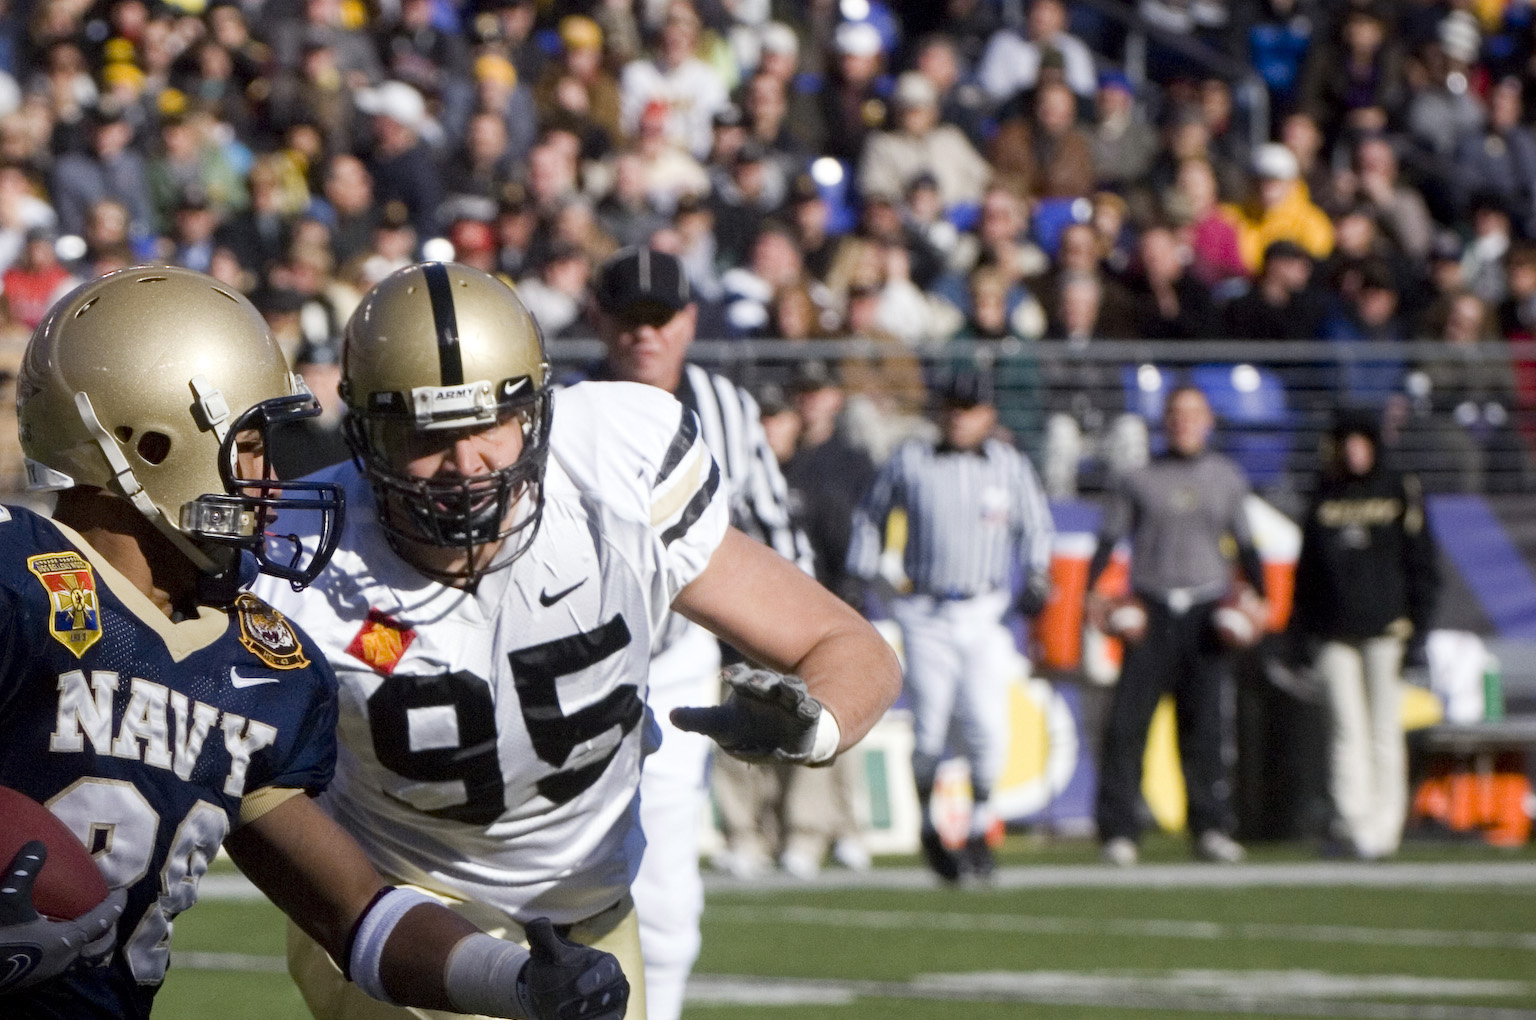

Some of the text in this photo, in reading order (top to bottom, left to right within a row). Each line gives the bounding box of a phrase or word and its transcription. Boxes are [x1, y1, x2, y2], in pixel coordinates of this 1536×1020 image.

[435, 387, 474, 401] ARMY
[49, 669, 278, 798] NAVY
[367, 613, 644, 827] 95
